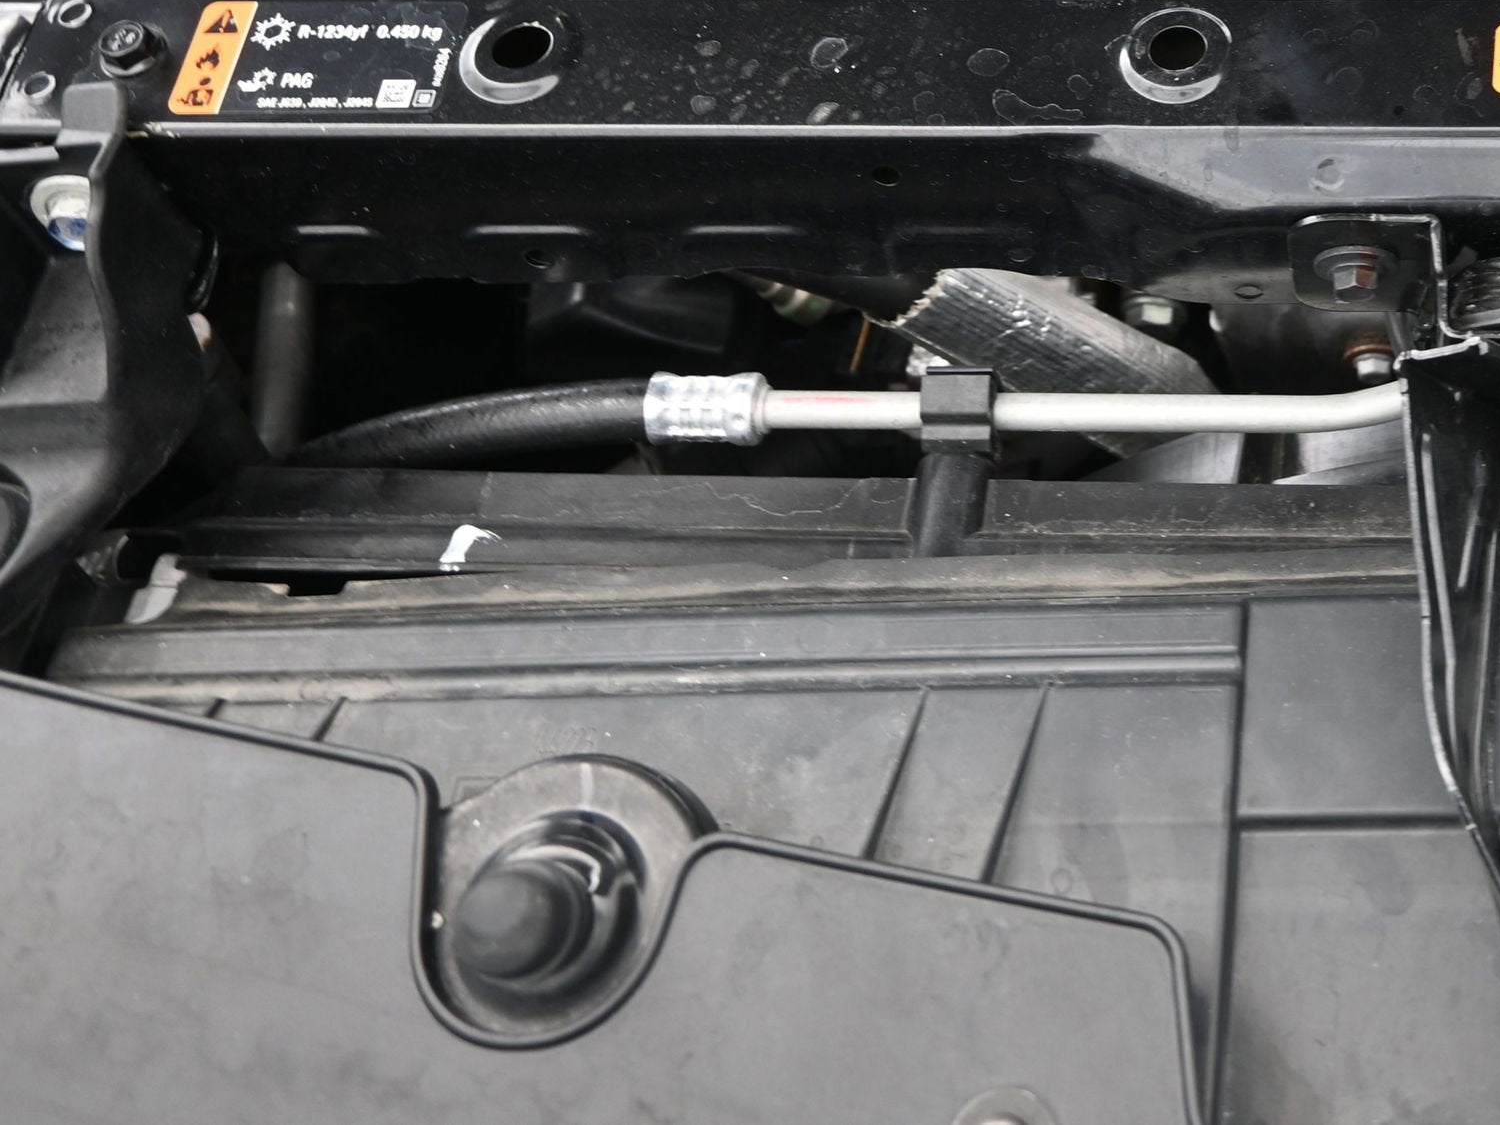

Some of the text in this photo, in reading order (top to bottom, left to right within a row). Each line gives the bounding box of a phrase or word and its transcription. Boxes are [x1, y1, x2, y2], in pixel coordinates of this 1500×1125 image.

[297, 24, 443, 42] R-1234yf 0.450 kg
[280, 72, 314, 89] PAG
[256, 97, 278, 108] SAE
